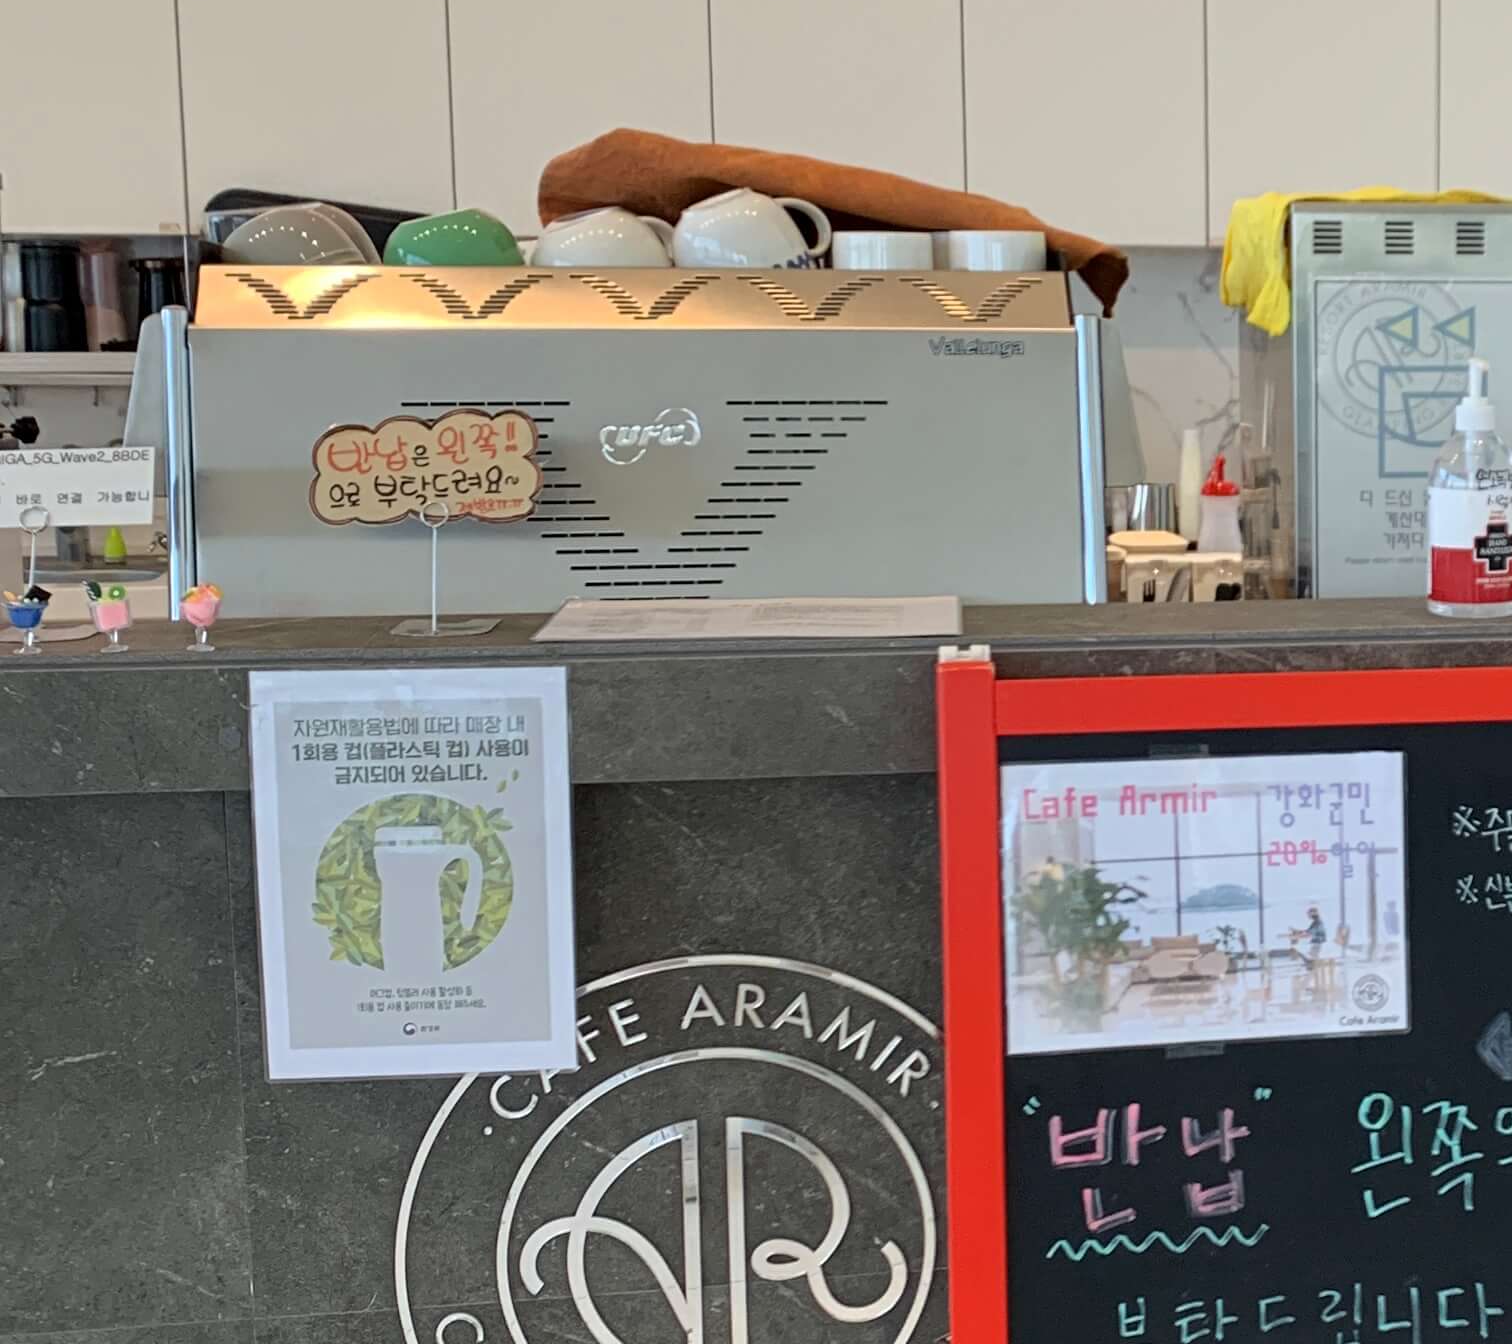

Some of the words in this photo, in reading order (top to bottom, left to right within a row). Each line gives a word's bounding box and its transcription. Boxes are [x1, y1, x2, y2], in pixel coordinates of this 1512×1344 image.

[327, 435, 430, 474] 반납은
[329, 482, 361, 508] 으로
[294, 717, 419, 738] 자원재활용법에
[424, 717, 460, 735] 따라
[466, 715, 502, 735] 매장
[507, 715, 525, 733] 내
[291, 743, 339, 762] 1회용
[476, 739, 529, 758] 사용이
[335, 766, 405, 785] 금지되어
[1023, 786, 1099, 821] Cafe
[1119, 783, 1218, 817] Armir
[1266, 839, 1329, 867] 20%
[489, 997, 649, 1120] CFE
[681, 983, 933, 1096] ARAMIR
